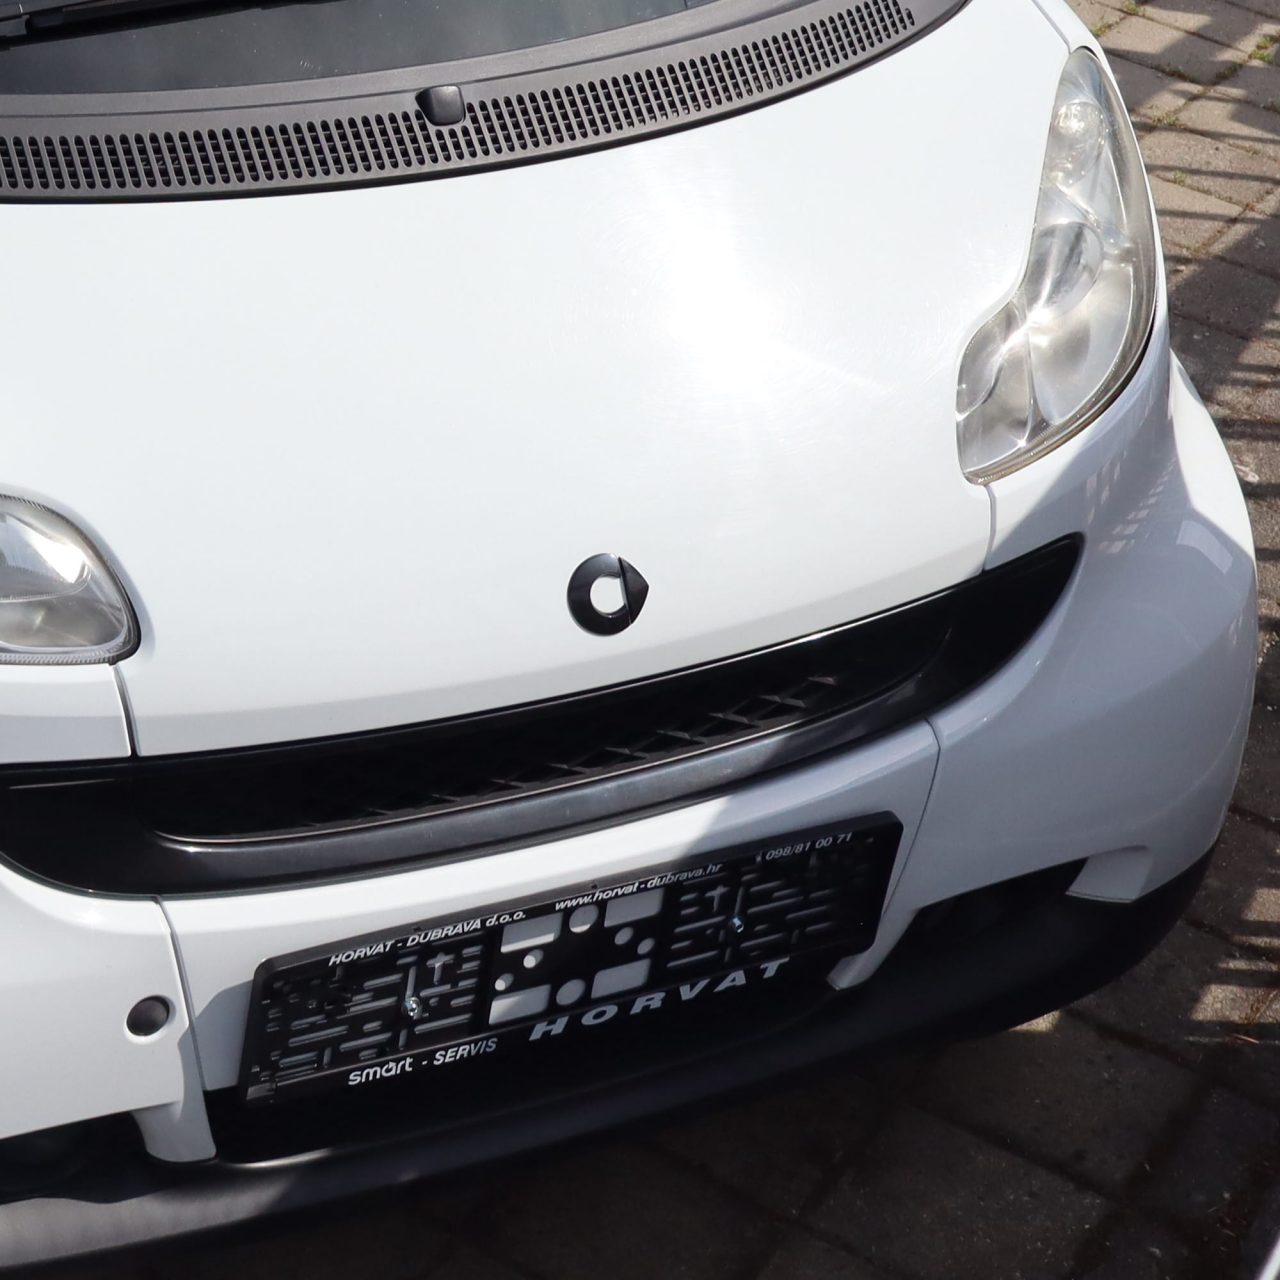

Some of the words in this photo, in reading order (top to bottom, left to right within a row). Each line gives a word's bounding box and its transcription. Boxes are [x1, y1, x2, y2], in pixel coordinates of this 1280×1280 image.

[765, 841, 811, 860] 098/81
[815, 836, 833, 849] 00
[837, 831, 853, 844] 71
[328, 939, 396, 966] HORVAT
[406, 919, 482, 948] DUBRAVA
[485, 911, 527, 927] d.o.o.
[528, 956, 790, 1040] HORVAT
[348, 1057, 414, 1085] smart
[433, 1037, 498, 1065] SERVIS
